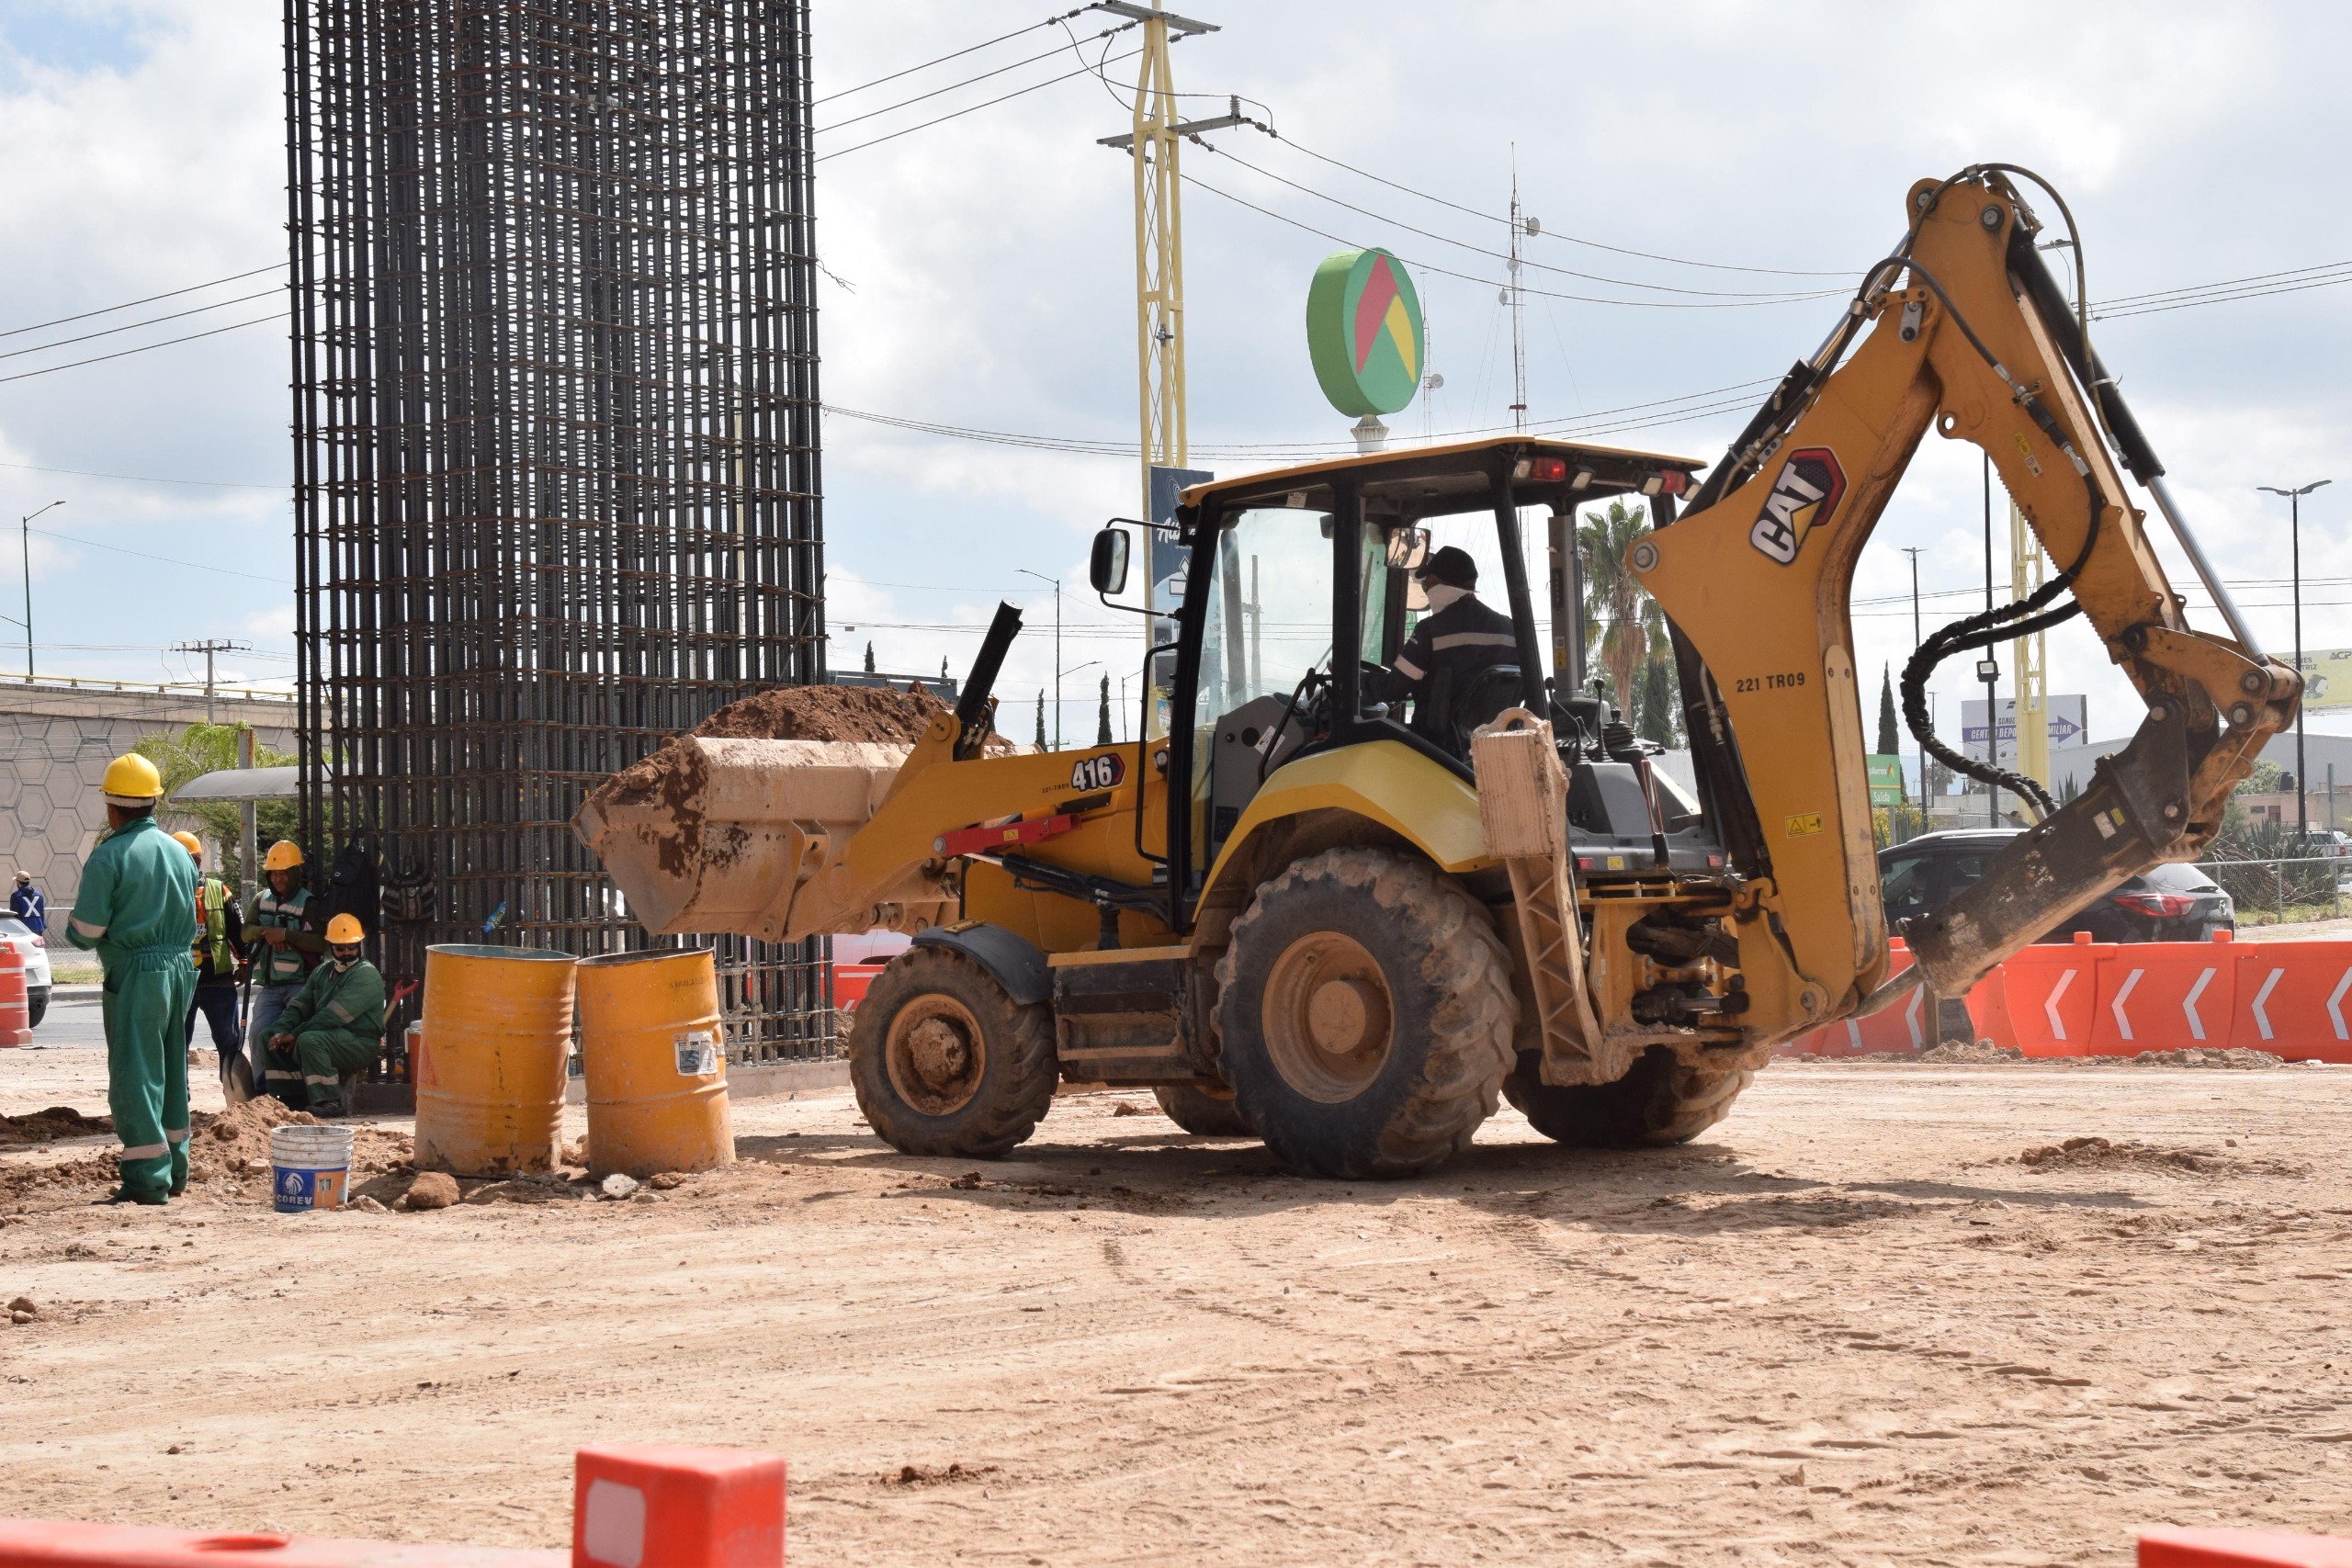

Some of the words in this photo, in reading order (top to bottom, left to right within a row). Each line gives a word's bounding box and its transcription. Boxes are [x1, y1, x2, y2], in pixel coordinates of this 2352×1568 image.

[1751, 461, 1825, 563] CAT
[1736, 677, 1760, 693] 221
[1766, 672, 1805, 689] TR09
[1971, 728, 1997, 739] CENT
[1998, 728, 2017, 739] DEPO
[2048, 724, 2072, 735] MILIAR
[1073, 756, 1113, 790] 416
[1873, 791, 1891, 802] Salida
[277, 1194, 312, 1204] COREV
